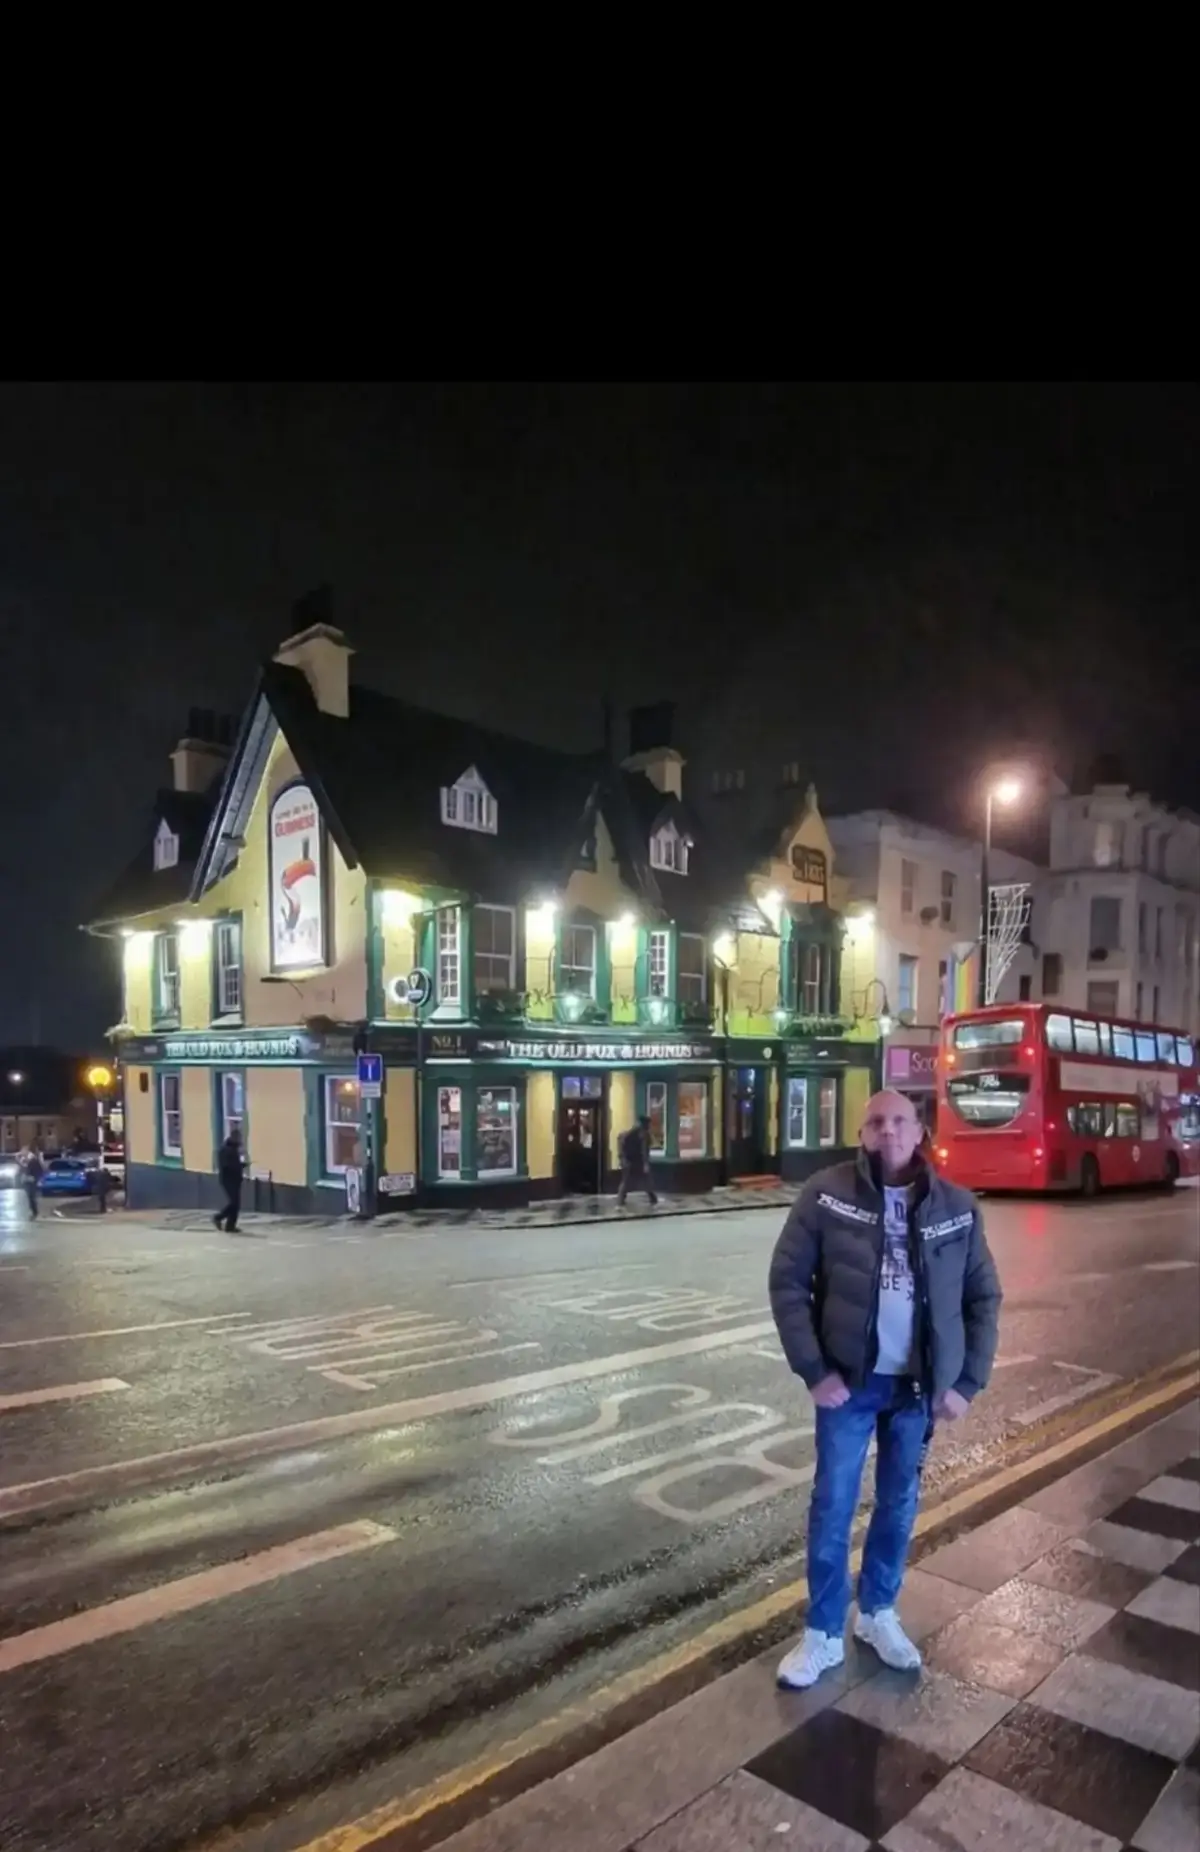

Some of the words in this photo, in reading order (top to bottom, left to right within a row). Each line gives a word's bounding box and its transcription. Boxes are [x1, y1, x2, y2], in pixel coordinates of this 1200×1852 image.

[507, 1040, 545, 1058] THE
[546, 1043, 582, 1059] OLD
[584, 1043, 616, 1059] FOX
[635, 1044, 692, 1059] HOUNDS
